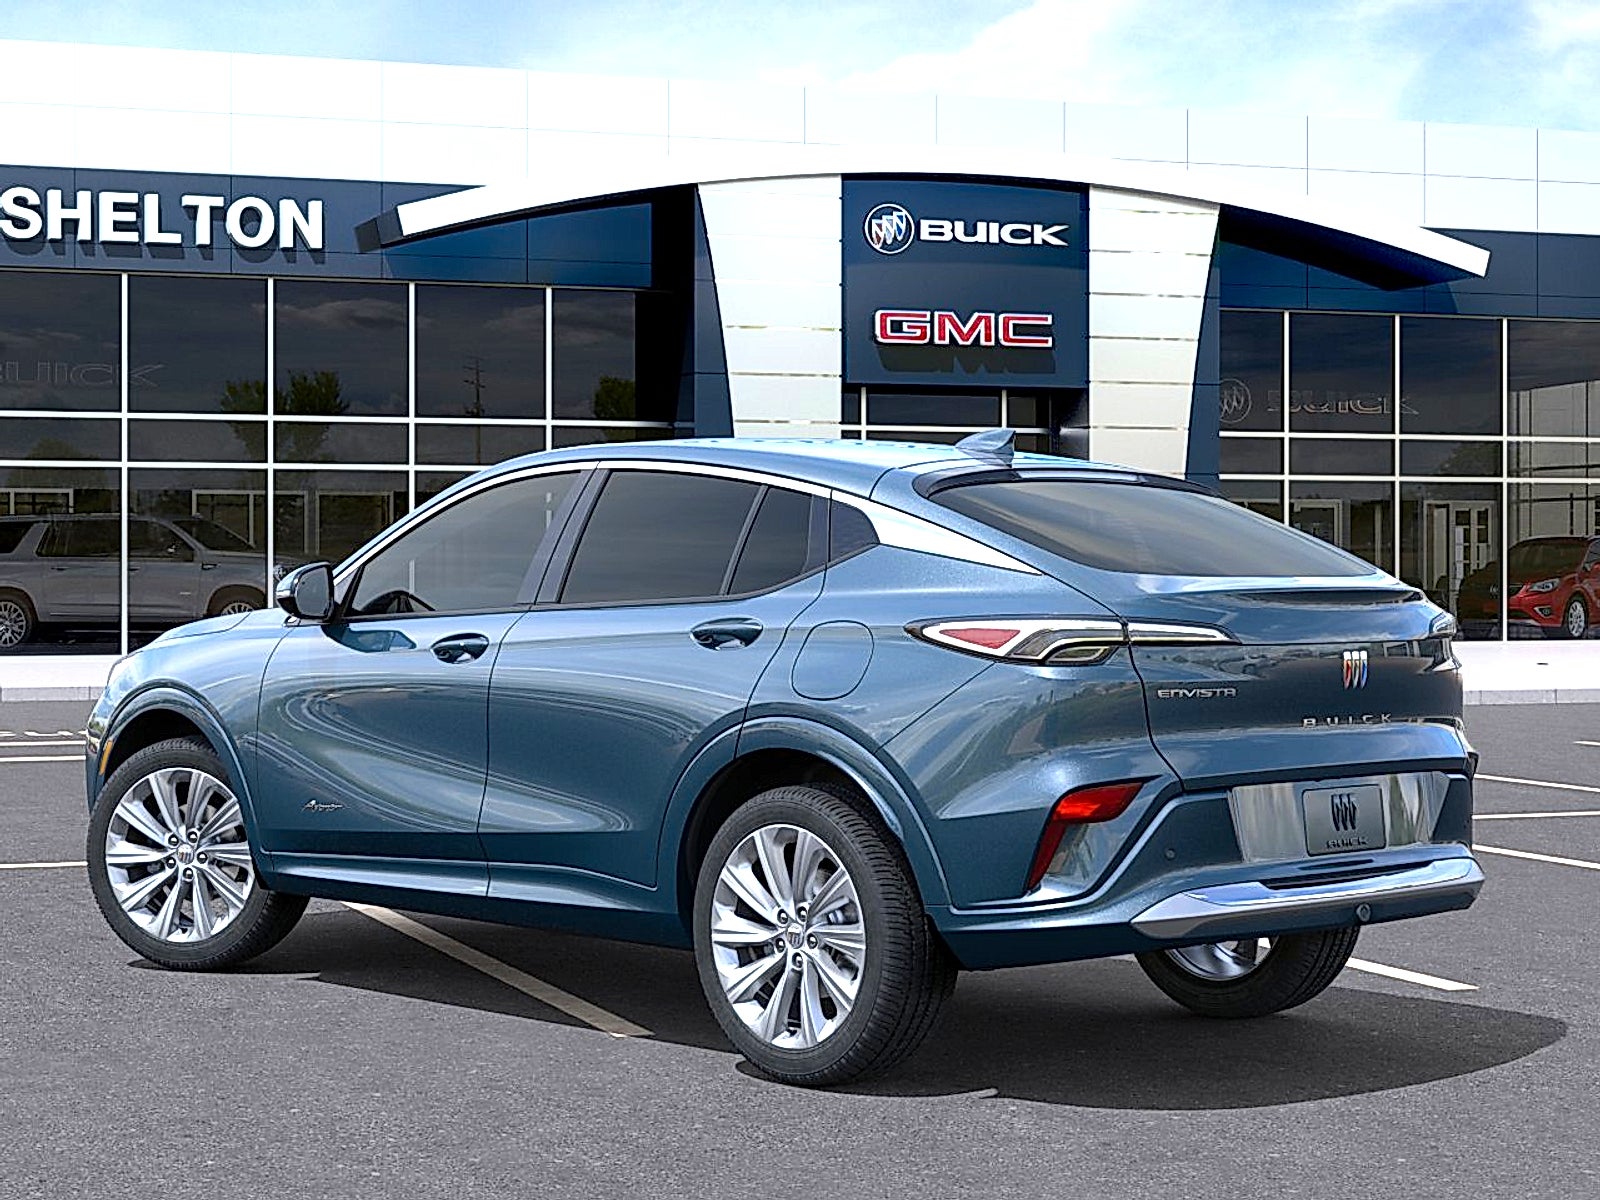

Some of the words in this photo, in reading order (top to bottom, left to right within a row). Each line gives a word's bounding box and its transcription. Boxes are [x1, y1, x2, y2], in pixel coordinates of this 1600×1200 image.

[0, 186, 323, 250] SHELTON
[919, 218, 1069, 247] BUICK
[874, 309, 1053, 348] GMC
[1157, 687, 1237, 699] ENVISTA
[1303, 713, 1392, 728] BUICK
[1326, 837, 1368, 849] BUICK
